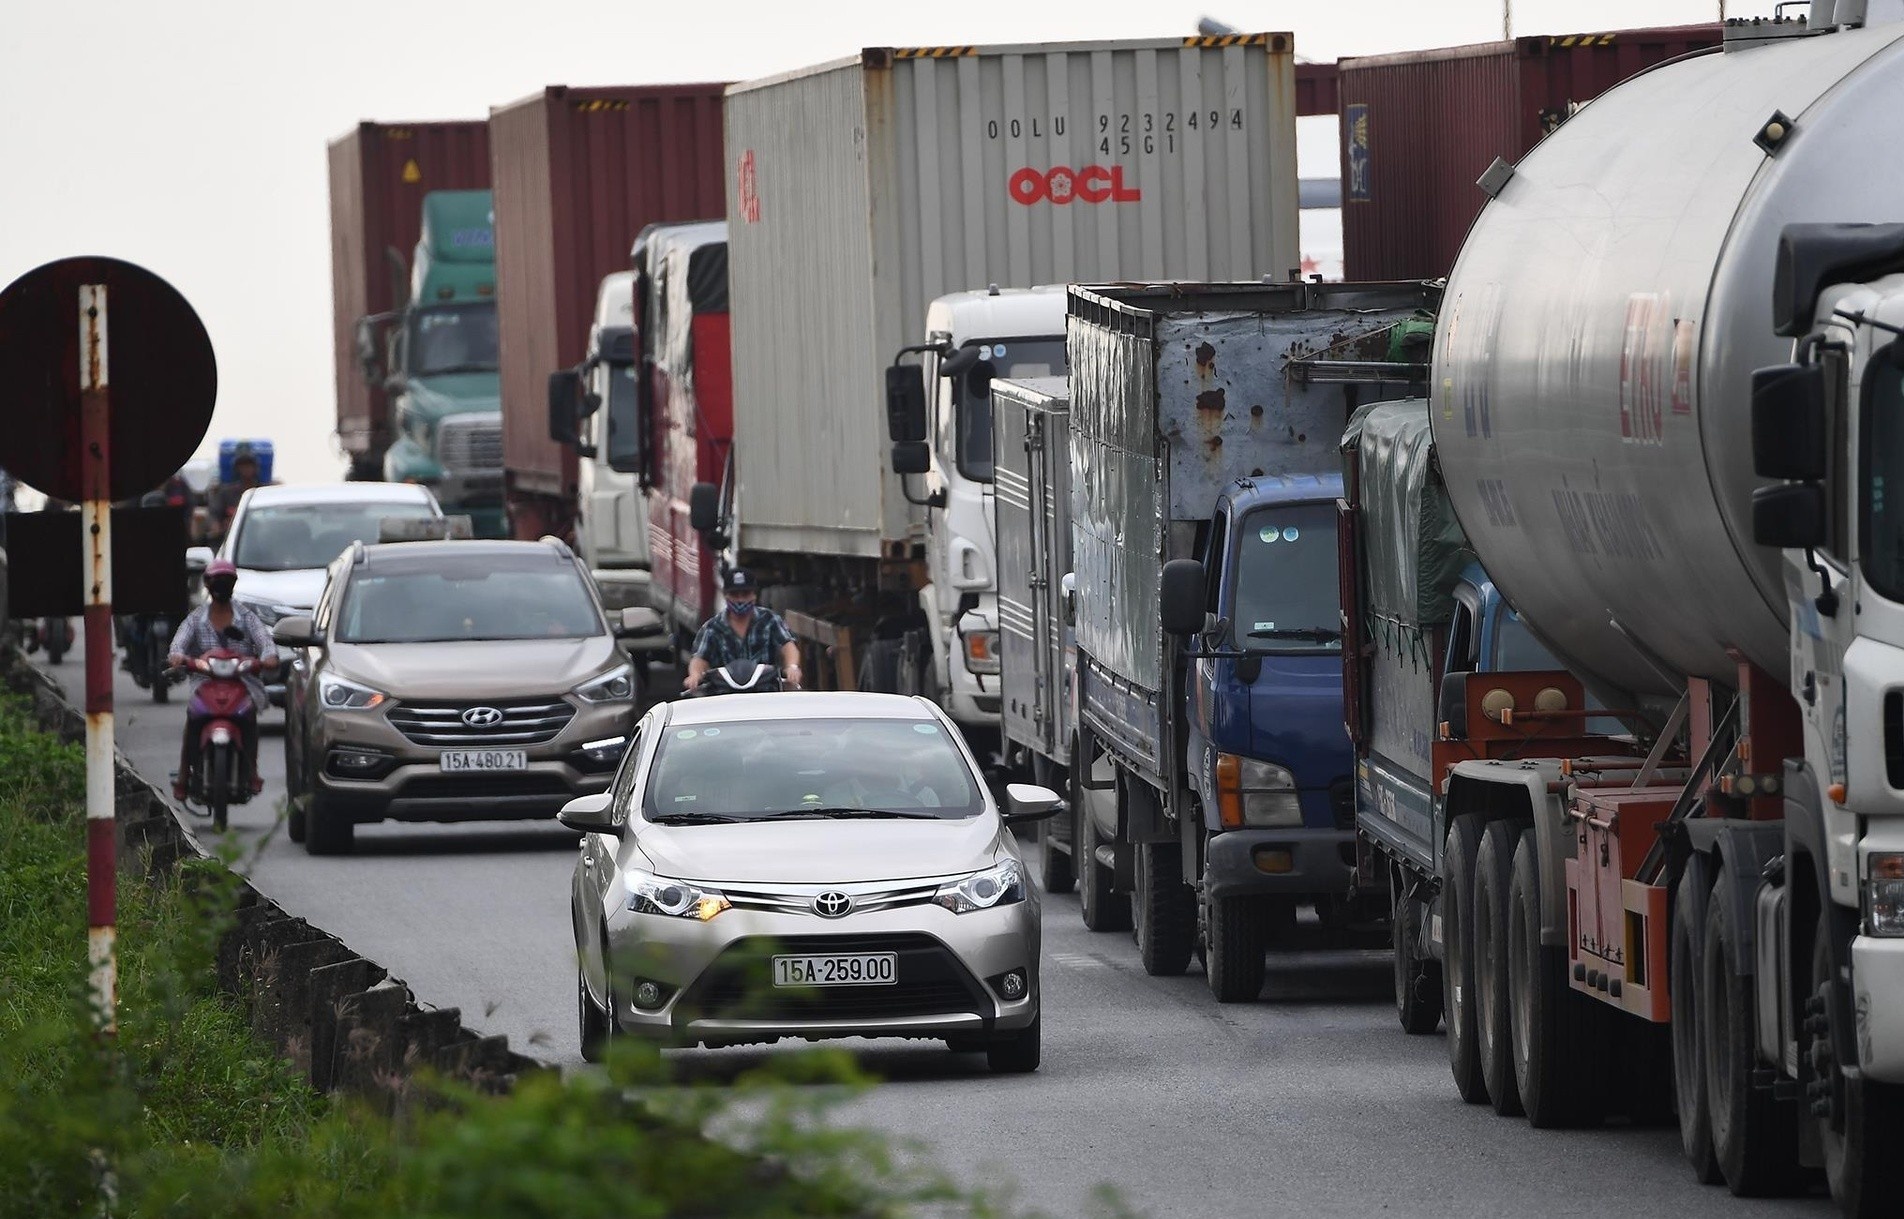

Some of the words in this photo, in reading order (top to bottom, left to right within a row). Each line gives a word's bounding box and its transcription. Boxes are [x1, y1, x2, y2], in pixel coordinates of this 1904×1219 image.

[1100, 134, 1175, 155] 45G1
[1009, 165, 1141, 205] OOCL
[780, 957, 892, 982] 15A-259.00
